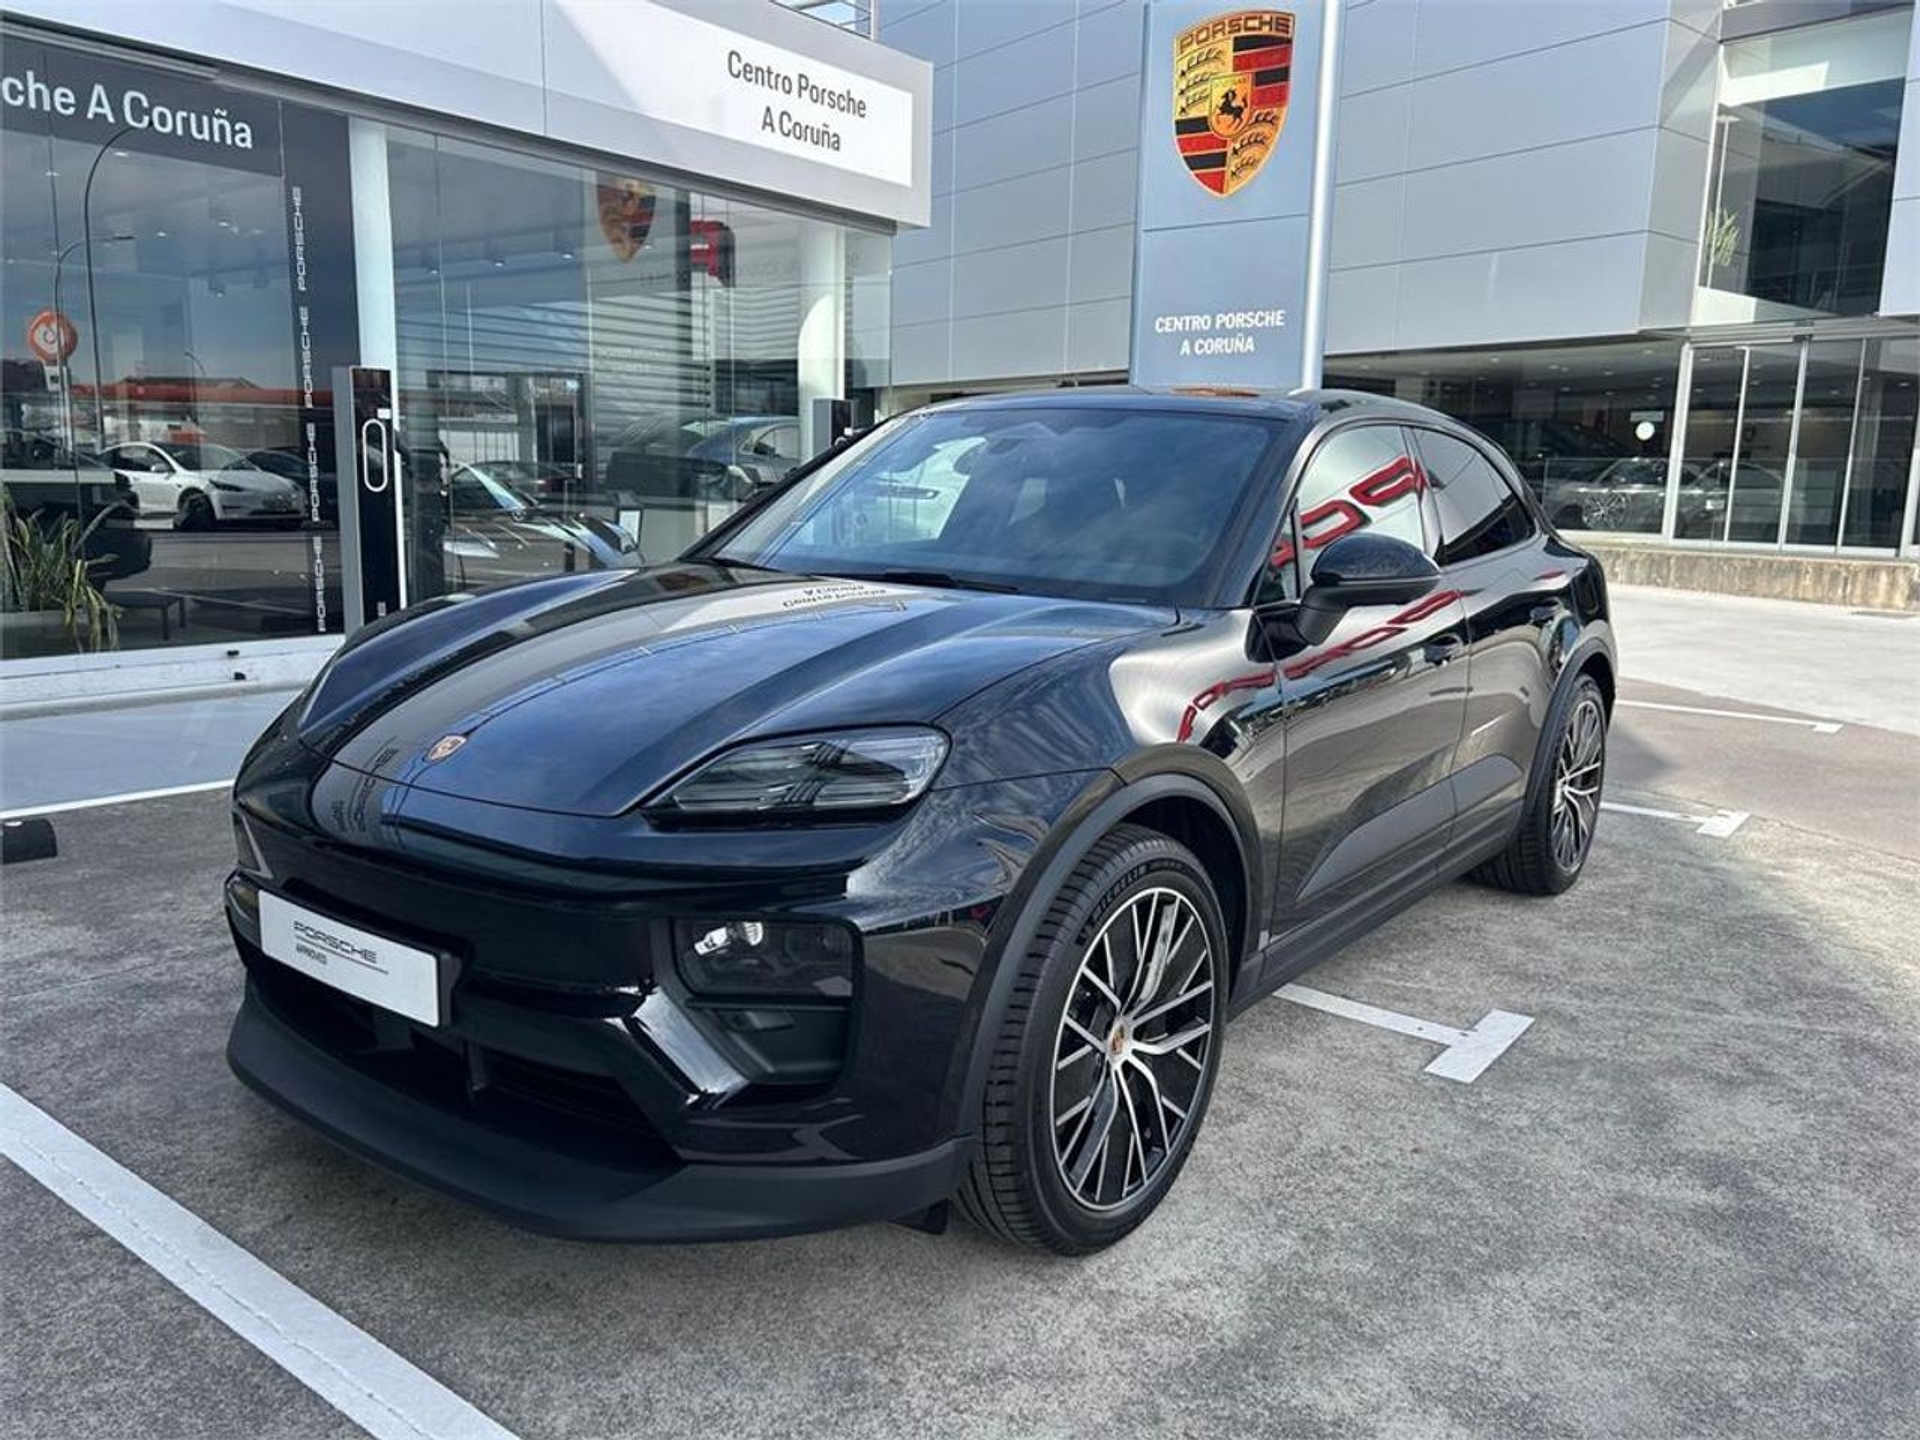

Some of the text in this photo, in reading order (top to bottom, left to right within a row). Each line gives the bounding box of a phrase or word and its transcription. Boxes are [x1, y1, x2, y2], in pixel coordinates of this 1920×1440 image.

[1180, 16, 1290, 53] PORSCHE
[87, 84, 115, 124] A
[123, 90, 253, 149] Coruña
[727, 50, 867, 118] Centro Porsche
[762, 106, 841, 151] A Coruña
[292, 186, 307, 292] PORSCHE
[1155, 309, 1286, 333] CENTRO PORSCHE
[1180, 332, 1255, 356] A CORUÑA
[300, 306, 314, 409] PORSCHE
[306, 422, 321, 522] PORSCHE
[313, 536, 326, 632] PORSCHE
[294, 920, 377, 964] PORSCHE
